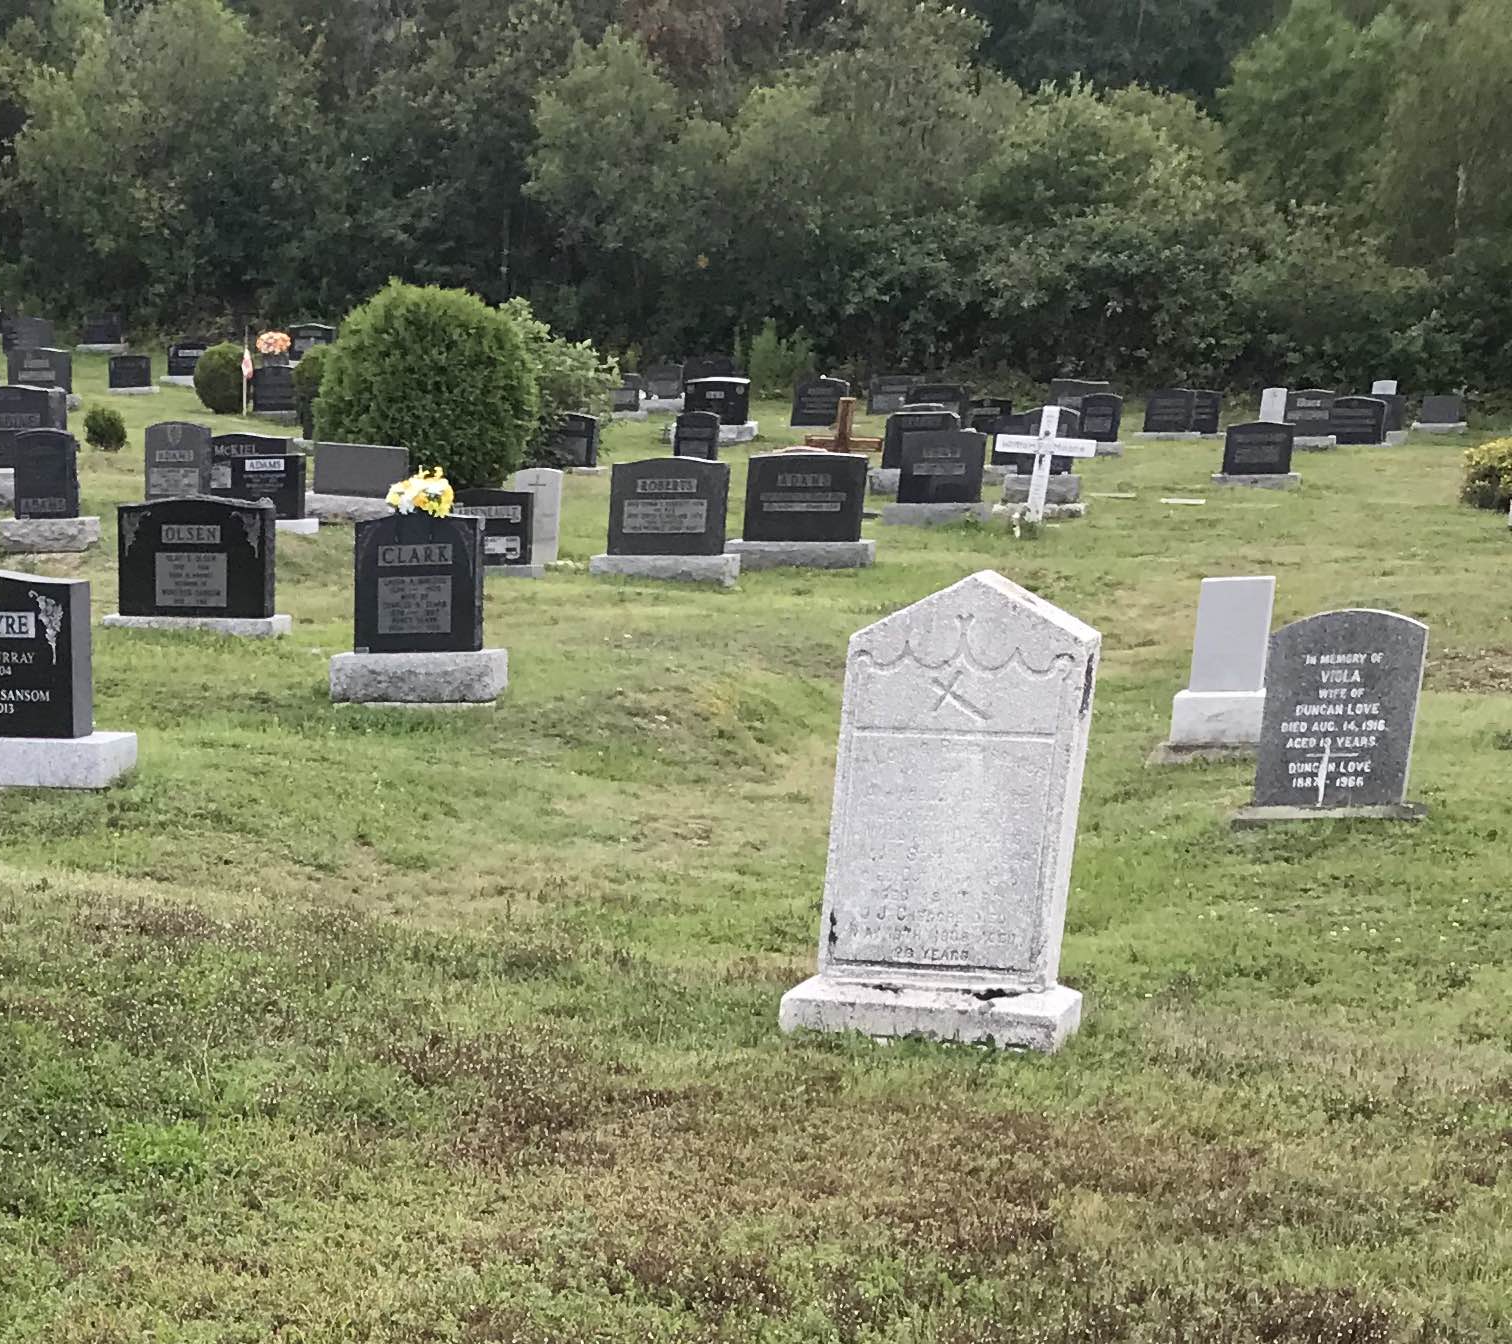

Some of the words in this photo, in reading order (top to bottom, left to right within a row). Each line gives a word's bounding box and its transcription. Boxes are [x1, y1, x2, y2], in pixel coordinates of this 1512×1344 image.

[165, 527, 217, 541] OLSEN
[382, 546, 448, 564] CLARK
[1320, 653, 1367, 664] MEMORY
[1321, 670, 1361, 683] VIOLA
[0, 689, 50, 702] SANSOM
[1319, 688, 1347, 698] WIFE
[1351, 688, 1365, 698] OF
[1296, 704, 1343, 716] DUNCAN
[1347, 703, 1380, 715] LOVE
[1281, 722, 1307, 732] DIED
[1286, 738, 1316, 748] AGED
[1289, 762, 1336, 774] DUNCN
[1340, 761, 1371, 773] LOVE
